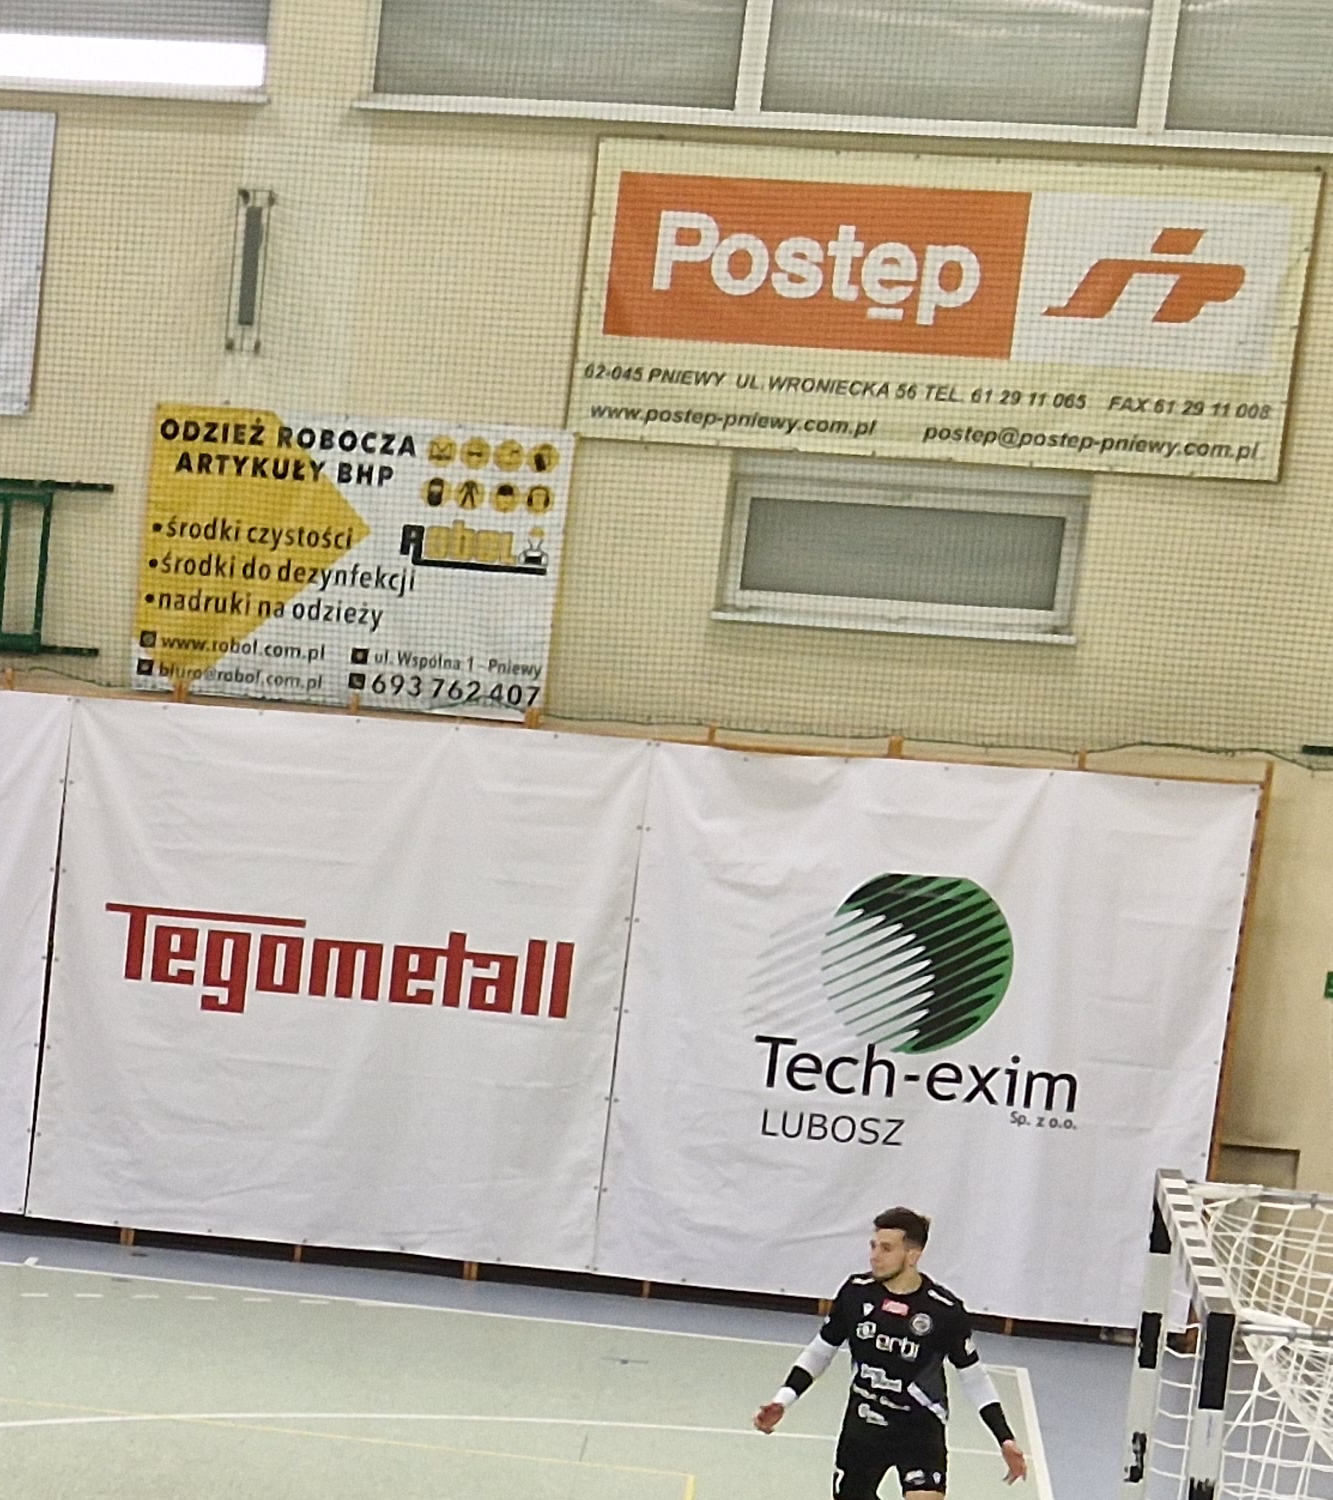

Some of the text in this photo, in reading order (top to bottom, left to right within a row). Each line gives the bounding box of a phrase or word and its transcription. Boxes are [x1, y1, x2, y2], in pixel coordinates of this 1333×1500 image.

[584, 364, 643, 382] 62-045
[648, 368, 726, 386] PNIEWY
[768, 375, 889, 398] WRONIECKA
[896, 383, 917, 399] 56
[971, 388, 992, 403] 61
[999, 389, 1021, 405] 29
[1032, 391, 1045, 406] 11
[1052, 392, 1086, 409] 065
[1107, 396, 1150, 413] FAX
[1153, 397, 1174, 414] 61
[1182, 400, 1203, 416] 29
[1211, 402, 1229, 417] 11
[1236, 403, 1271, 420] 008
[160, 418, 416, 457] ODZIEŻ ROBOCZA
[591, 403, 1260, 461] www.postep-pniewy.com.pl postep@postep-pniewy.com.pl
[175, 452, 394, 487] ARTYKUŁY BHP
[167, 517, 353, 551] środki czystości
[163, 552, 416, 597] środki do dezynfekcji
[159, 590, 384, 631] nadruki na odzieży
[161, 635, 325, 661] www.robol.com.pl
[375, 650, 393, 664] ul.
[397, 650, 461, 672] Wspólna
[466, 658, 474, 670] 1
[489, 658, 542, 679] Pniewy
[159, 662, 322, 690] biuro@robol.com.pl
[371, 673, 541, 707] 693 762 407
[105, 902, 575, 1019] Tegometall
[755, 1035, 1079, 1114] Tech-exim
[760, 1108, 906, 1147] LUBOSZ
[1010, 1111, 1078, 1131] Sp. z o.o.
